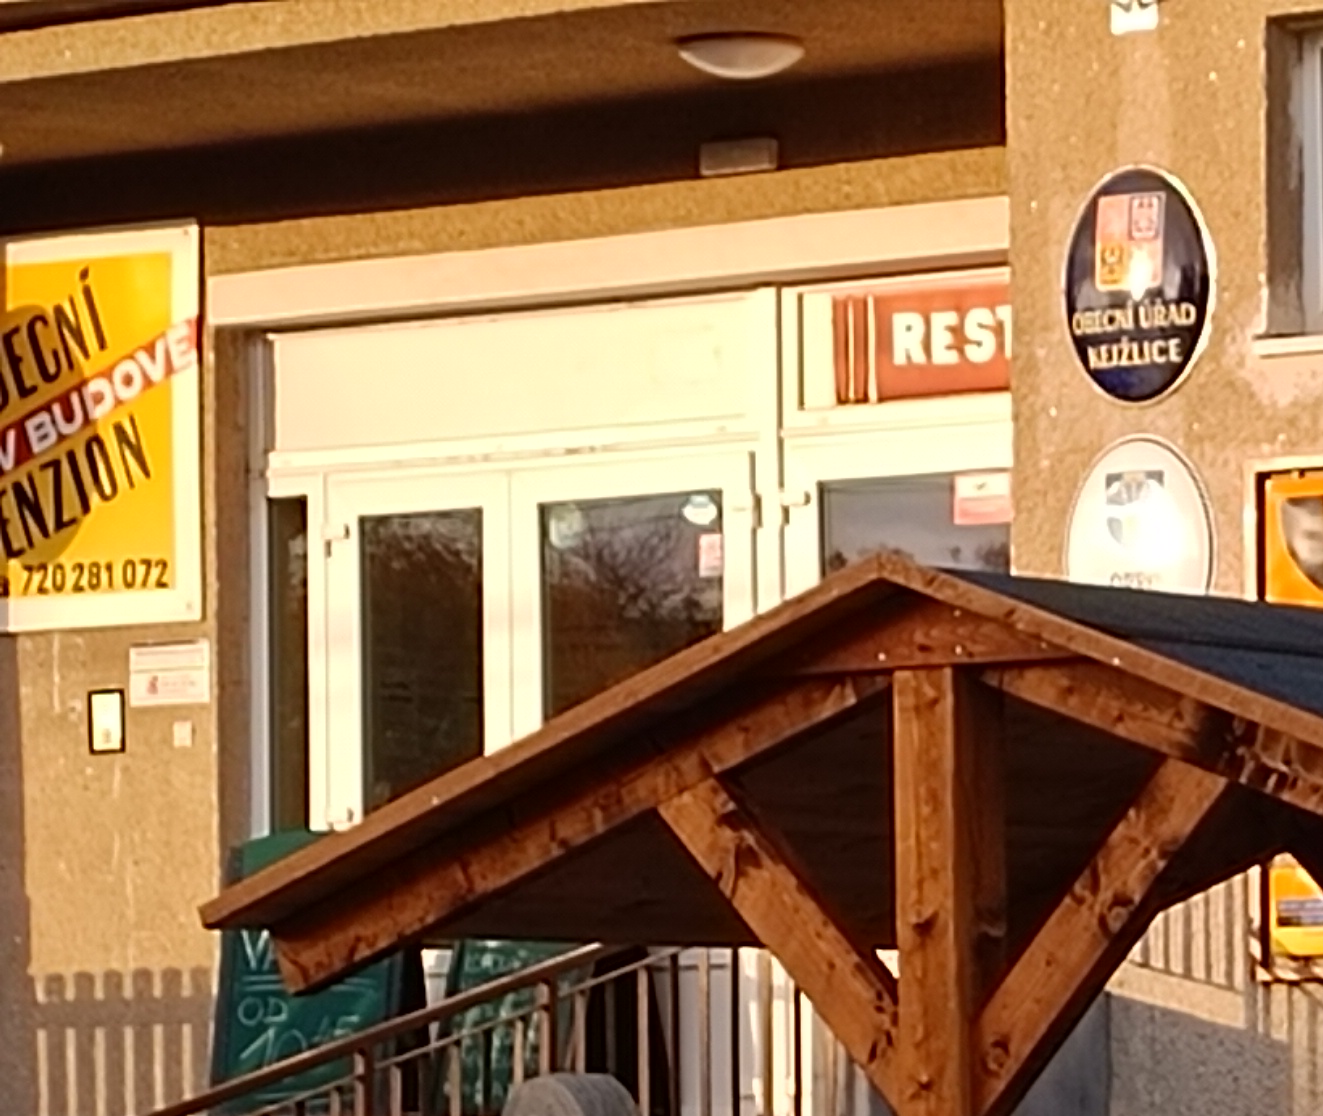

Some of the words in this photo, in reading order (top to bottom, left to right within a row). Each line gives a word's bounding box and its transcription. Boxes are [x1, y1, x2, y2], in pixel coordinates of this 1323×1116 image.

[1138, 298, 1197, 329] ÚŘAD
[0, 265, 108, 412] ECNÍ
[1086, 335, 1183, 370] KEJŽLICE
[22, 562, 66, 596] 720
[71, 560, 114, 594] 281
[121, 558, 170, 590] 072
